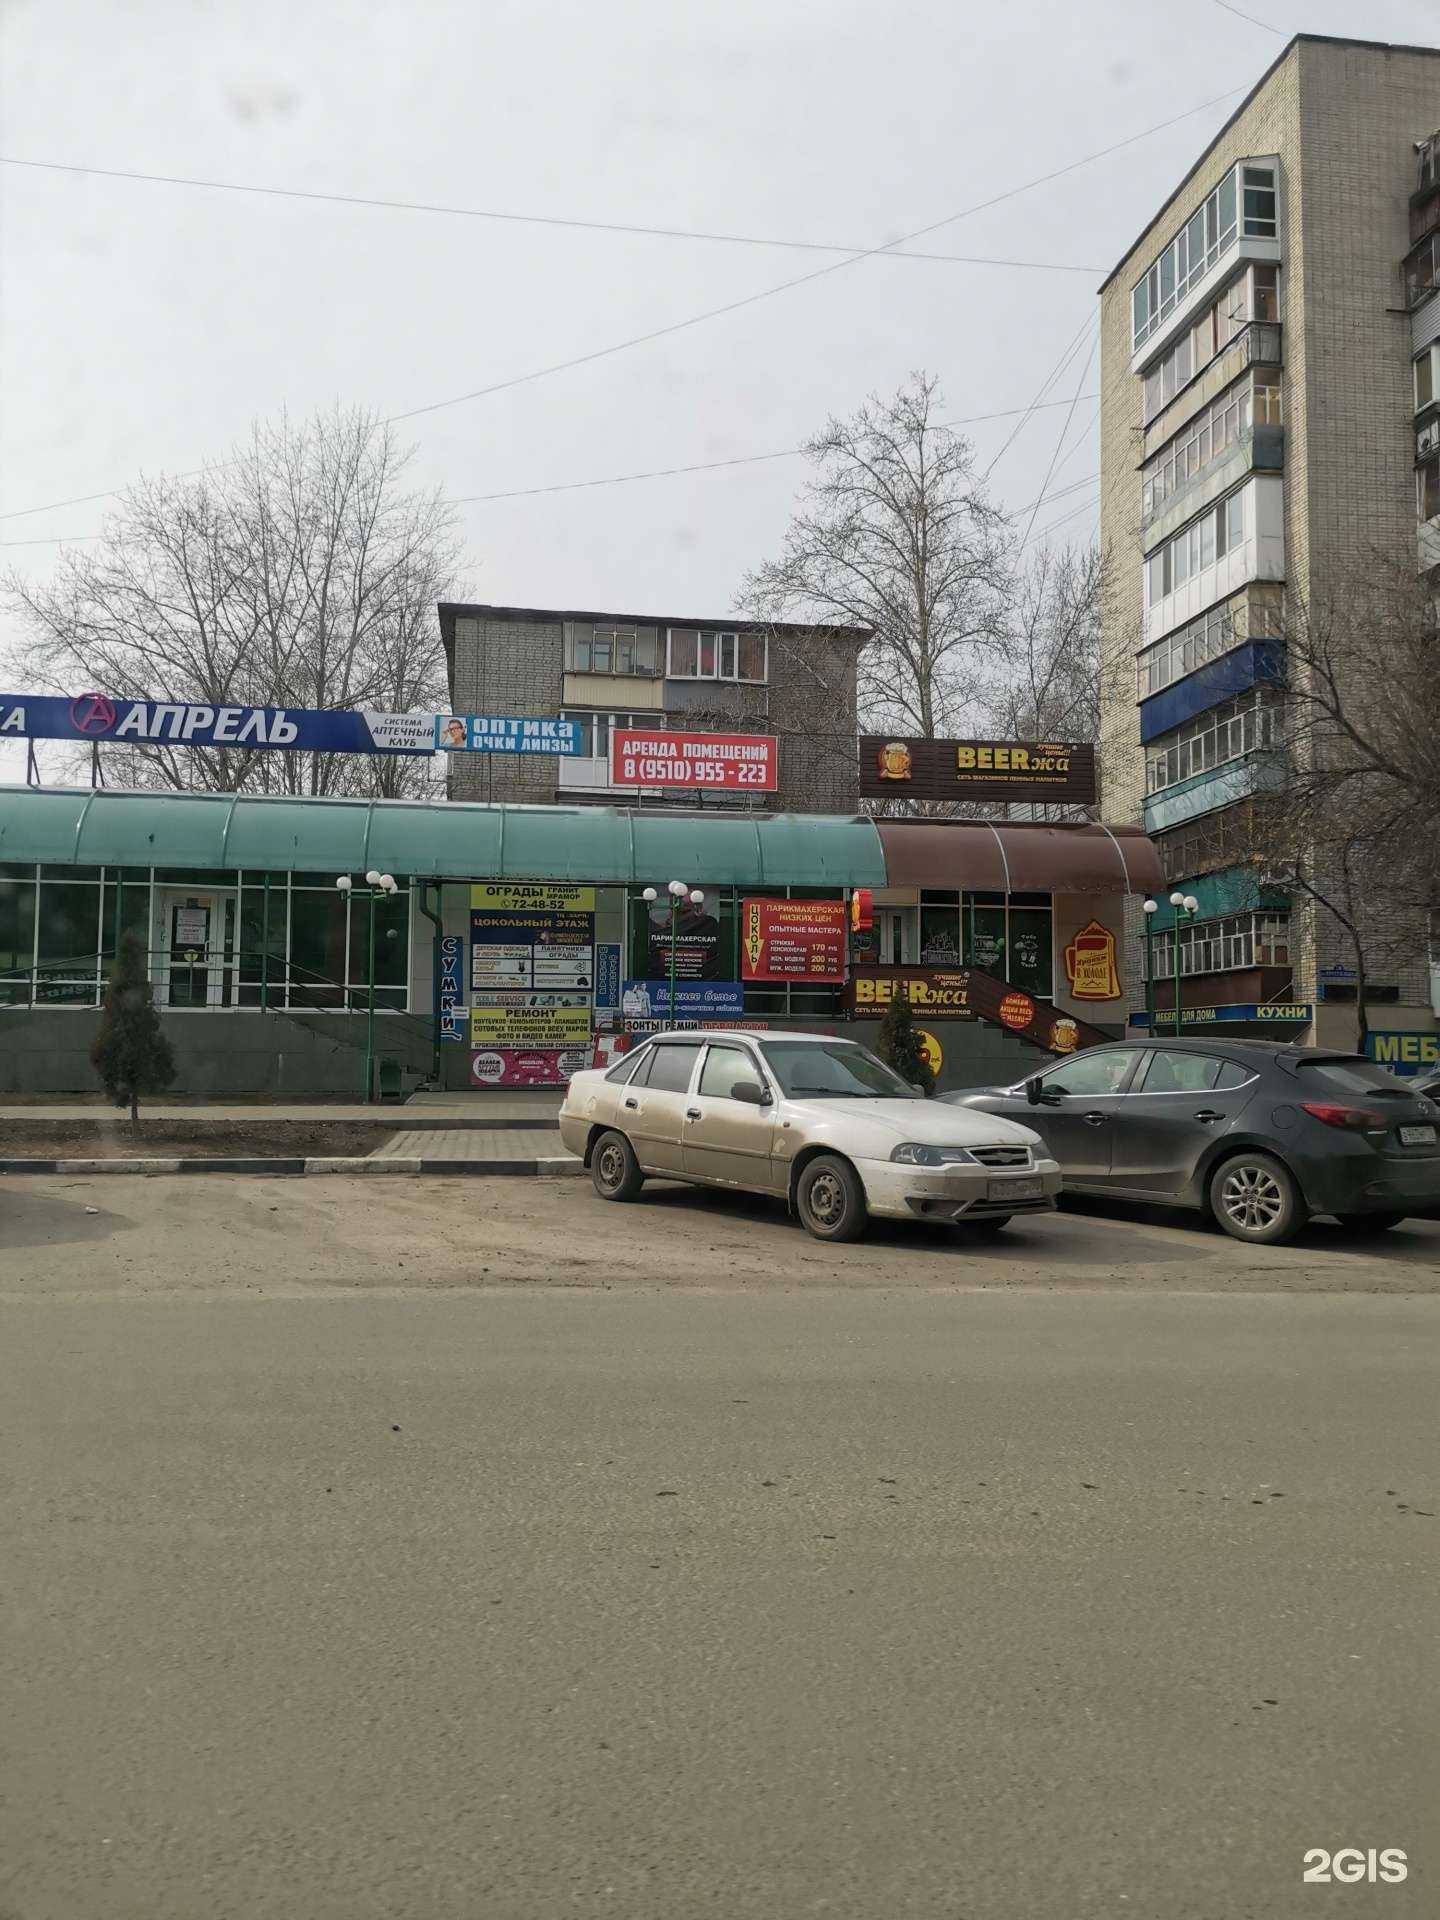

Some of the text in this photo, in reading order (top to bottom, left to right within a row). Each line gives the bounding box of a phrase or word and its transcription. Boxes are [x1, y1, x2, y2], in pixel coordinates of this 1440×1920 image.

[115, 703, 299, 745] АПРЕЛЬ
[384, 718, 422, 727] СИСТЕМА
[372, 726, 435, 738] АПТЕЧНЫЙ
[388, 738, 417, 748] КЛУБ
[473, 735, 574, 752] ОЧКИ ЛИНЗЫ
[622, 740, 768, 761] АРЕНДА ПОМЕЩЕНИЙ
[624, 759, 636, 778] 8
[639, 759, 691, 781] (9510)
[695, 762, 725, 782] 955
[738, 764, 767, 783] 223
[486, 886, 544, 898] ОГРАДЫ
[511, 900, 565, 910] 72-48-52
[766, 904, 845, 914] ПАРИКМАХЕРСКАЯ
[474, 918, 589, 928] ЦОКОЛЬНЫЙ ЭТАЖ
[779, 914, 832, 923] НИЗКИХ ЦЕН
[750, 905, 759, 963] ЦОКОЛЬ
[769, 925, 842, 934] ОПЫТНЫЕ МАСТЕРА
[811, 955, 826, 963] 200
[811, 964, 825, 972] 200
[440, 937, 458, 1031] СУМКИ
[506, 1009, 558, 1018] РЕМОНТ
[1155, 1009, 1217, 1022] МЕБЕЛ ДЛЯ ДОМА
[1256, 1006, 1307, 1018] КУХНИ
[665, 1020, 698, 1030] РЕМНИ
